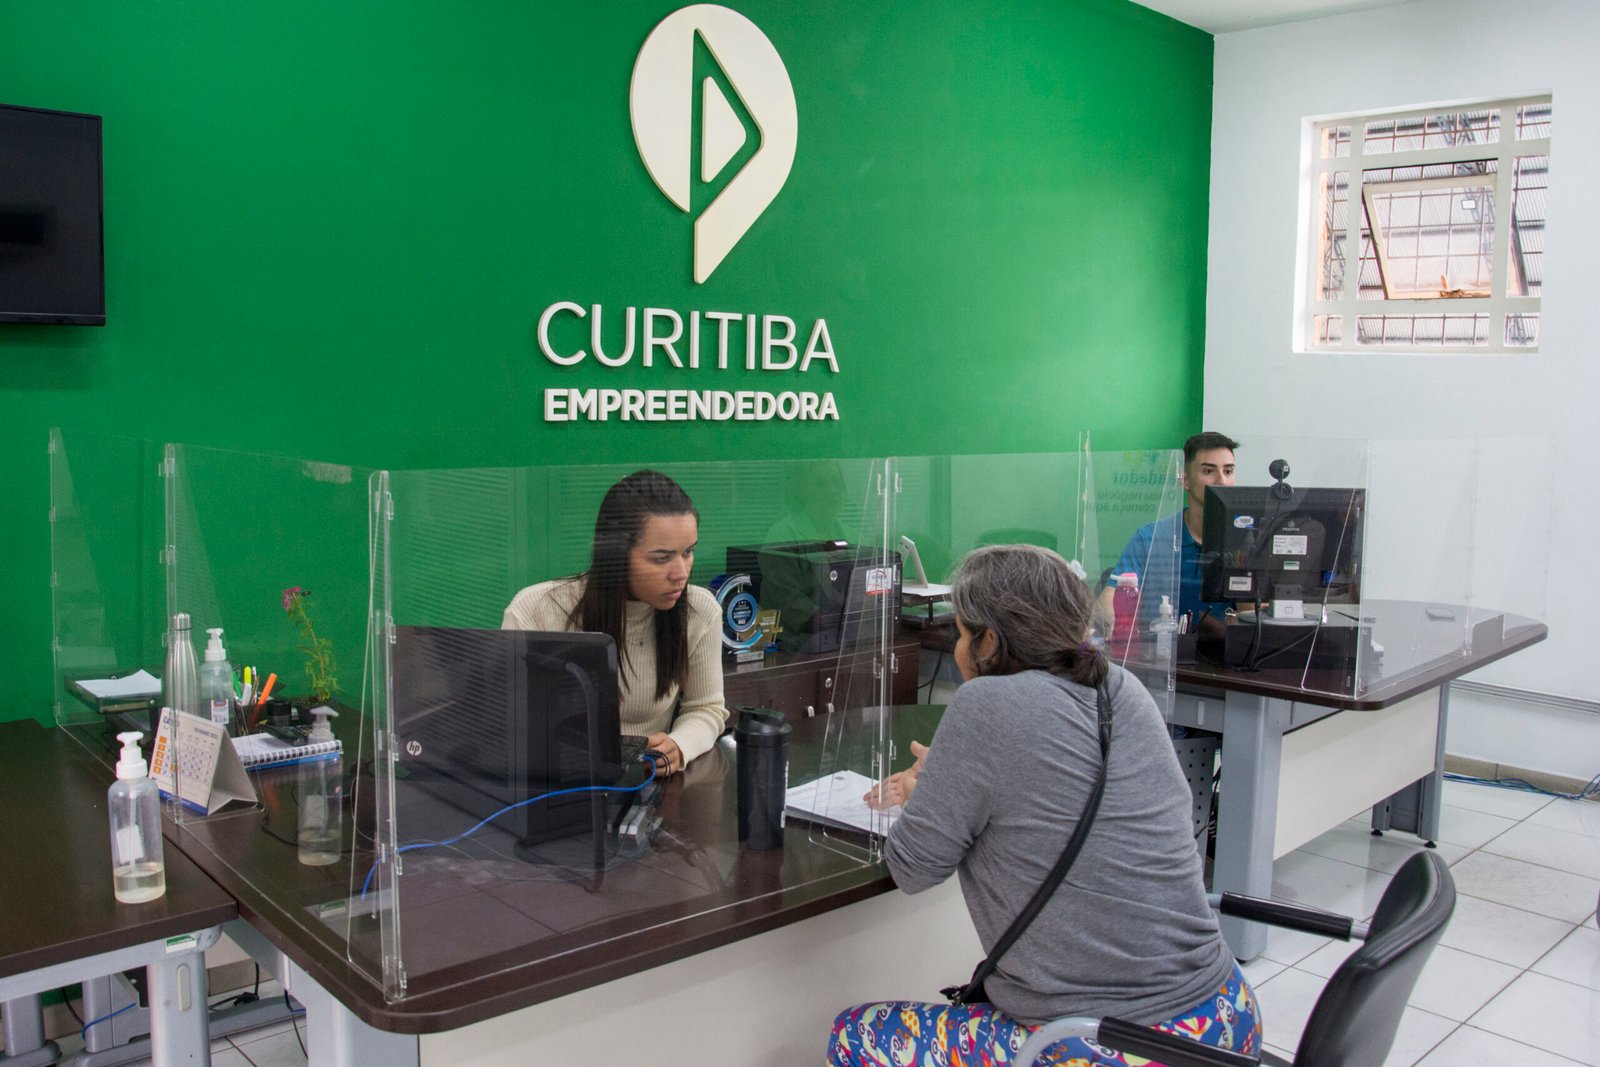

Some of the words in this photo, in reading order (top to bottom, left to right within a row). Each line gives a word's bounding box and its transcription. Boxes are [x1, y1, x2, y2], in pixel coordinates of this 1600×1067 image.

[537, 301, 840, 373] CURITIBA
[544, 388, 840, 421] EMPREENDEDORA
[406, 740, 422, 756] hp
